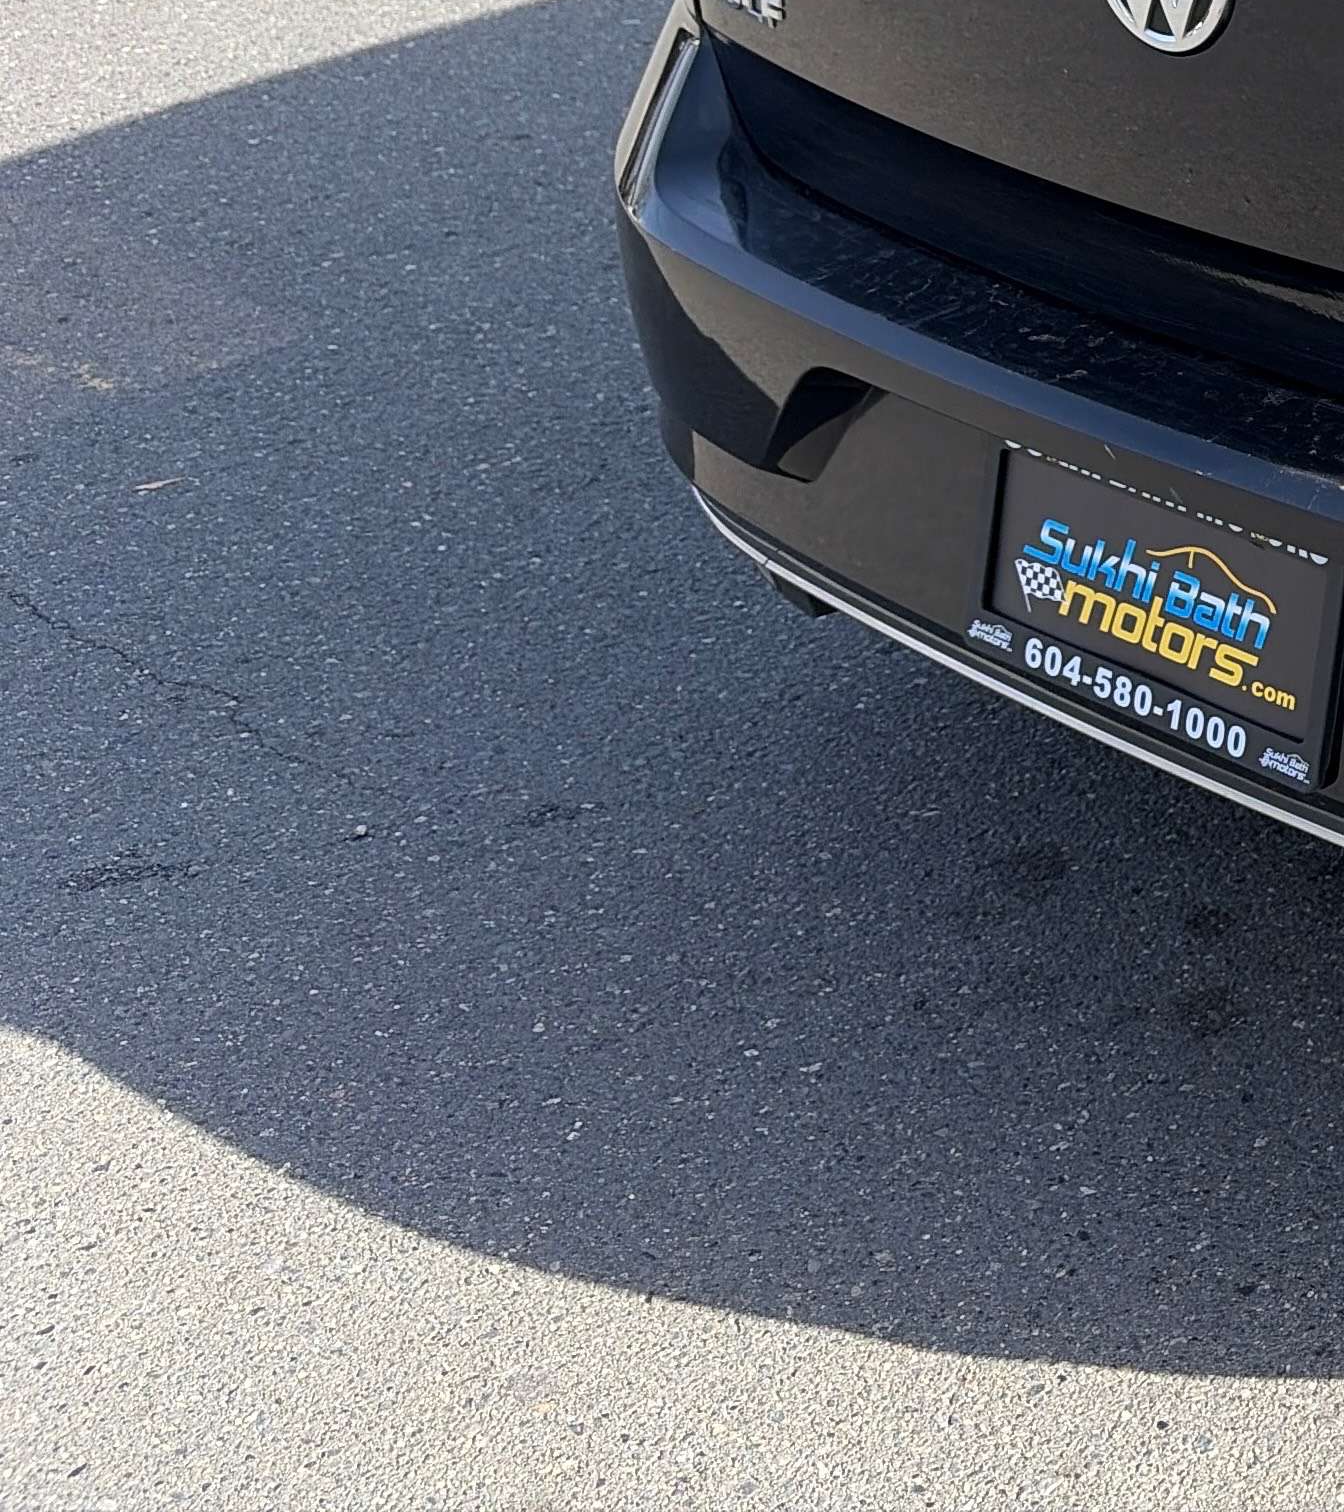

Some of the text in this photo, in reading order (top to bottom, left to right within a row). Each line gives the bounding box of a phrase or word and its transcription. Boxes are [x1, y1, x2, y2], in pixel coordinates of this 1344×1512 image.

[1023, 518, 1271, 650] Sukhi Bath
[1025, 638, 1247, 759] 604-580-1000
